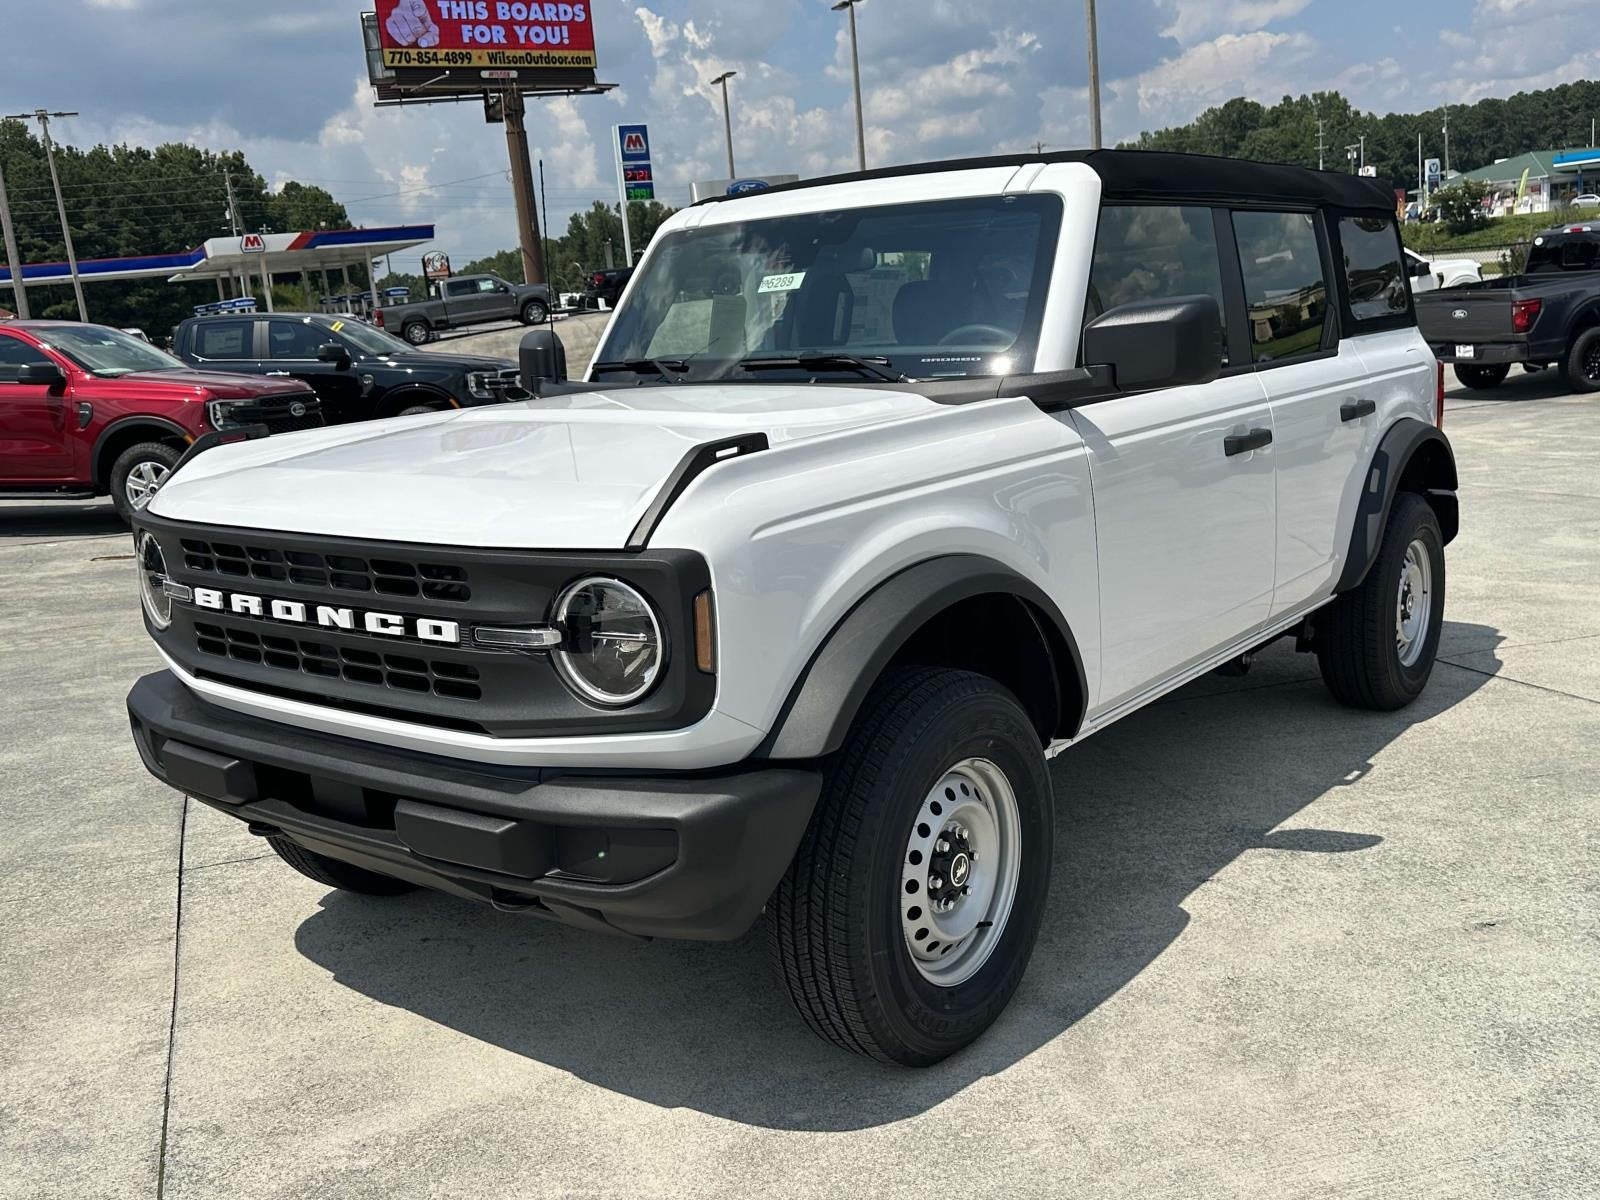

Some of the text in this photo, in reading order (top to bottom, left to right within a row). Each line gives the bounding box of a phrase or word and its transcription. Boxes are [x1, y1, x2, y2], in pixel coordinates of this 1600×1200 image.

[437, 1, 586, 22] THIS BOARDS
[461, 25, 570, 44] FOR YOU!
[389, 51, 592, 65] 770-854-4899 WilsonOutdoor.com
[193, 587, 460, 643] BRONCO
